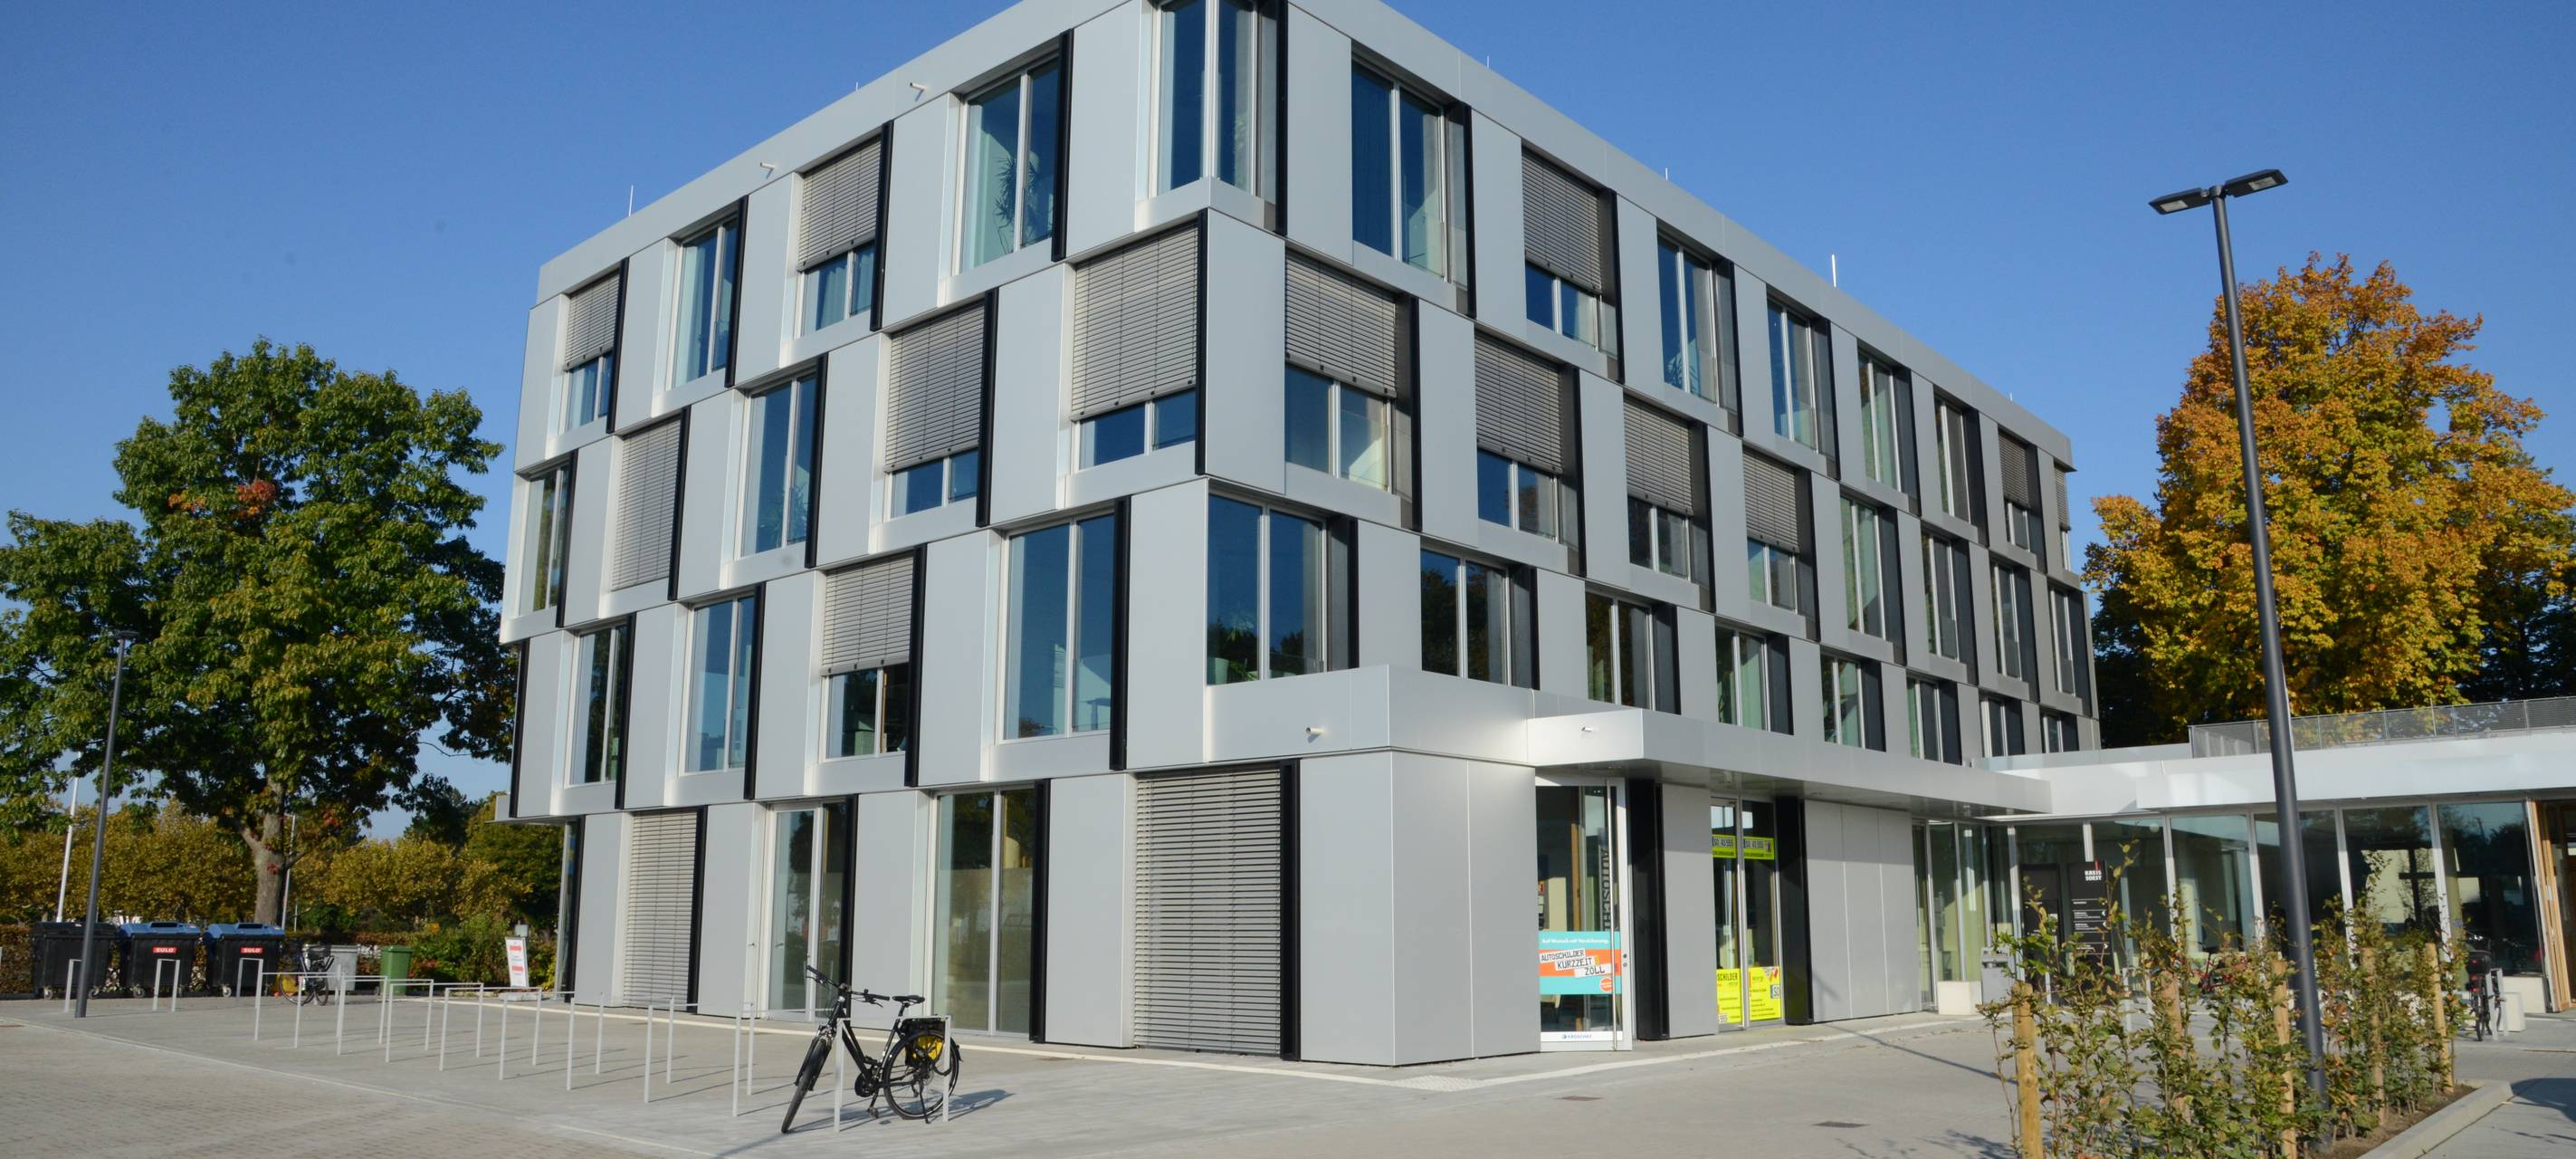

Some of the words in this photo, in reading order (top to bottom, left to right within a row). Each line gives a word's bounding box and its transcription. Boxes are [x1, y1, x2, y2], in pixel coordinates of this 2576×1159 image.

[1541, 949, 1585, 962] AUTOSCHILDER
[1557, 957, 1592, 969] KURZZEIT
[1585, 966, 1605, 975] ZOLL
